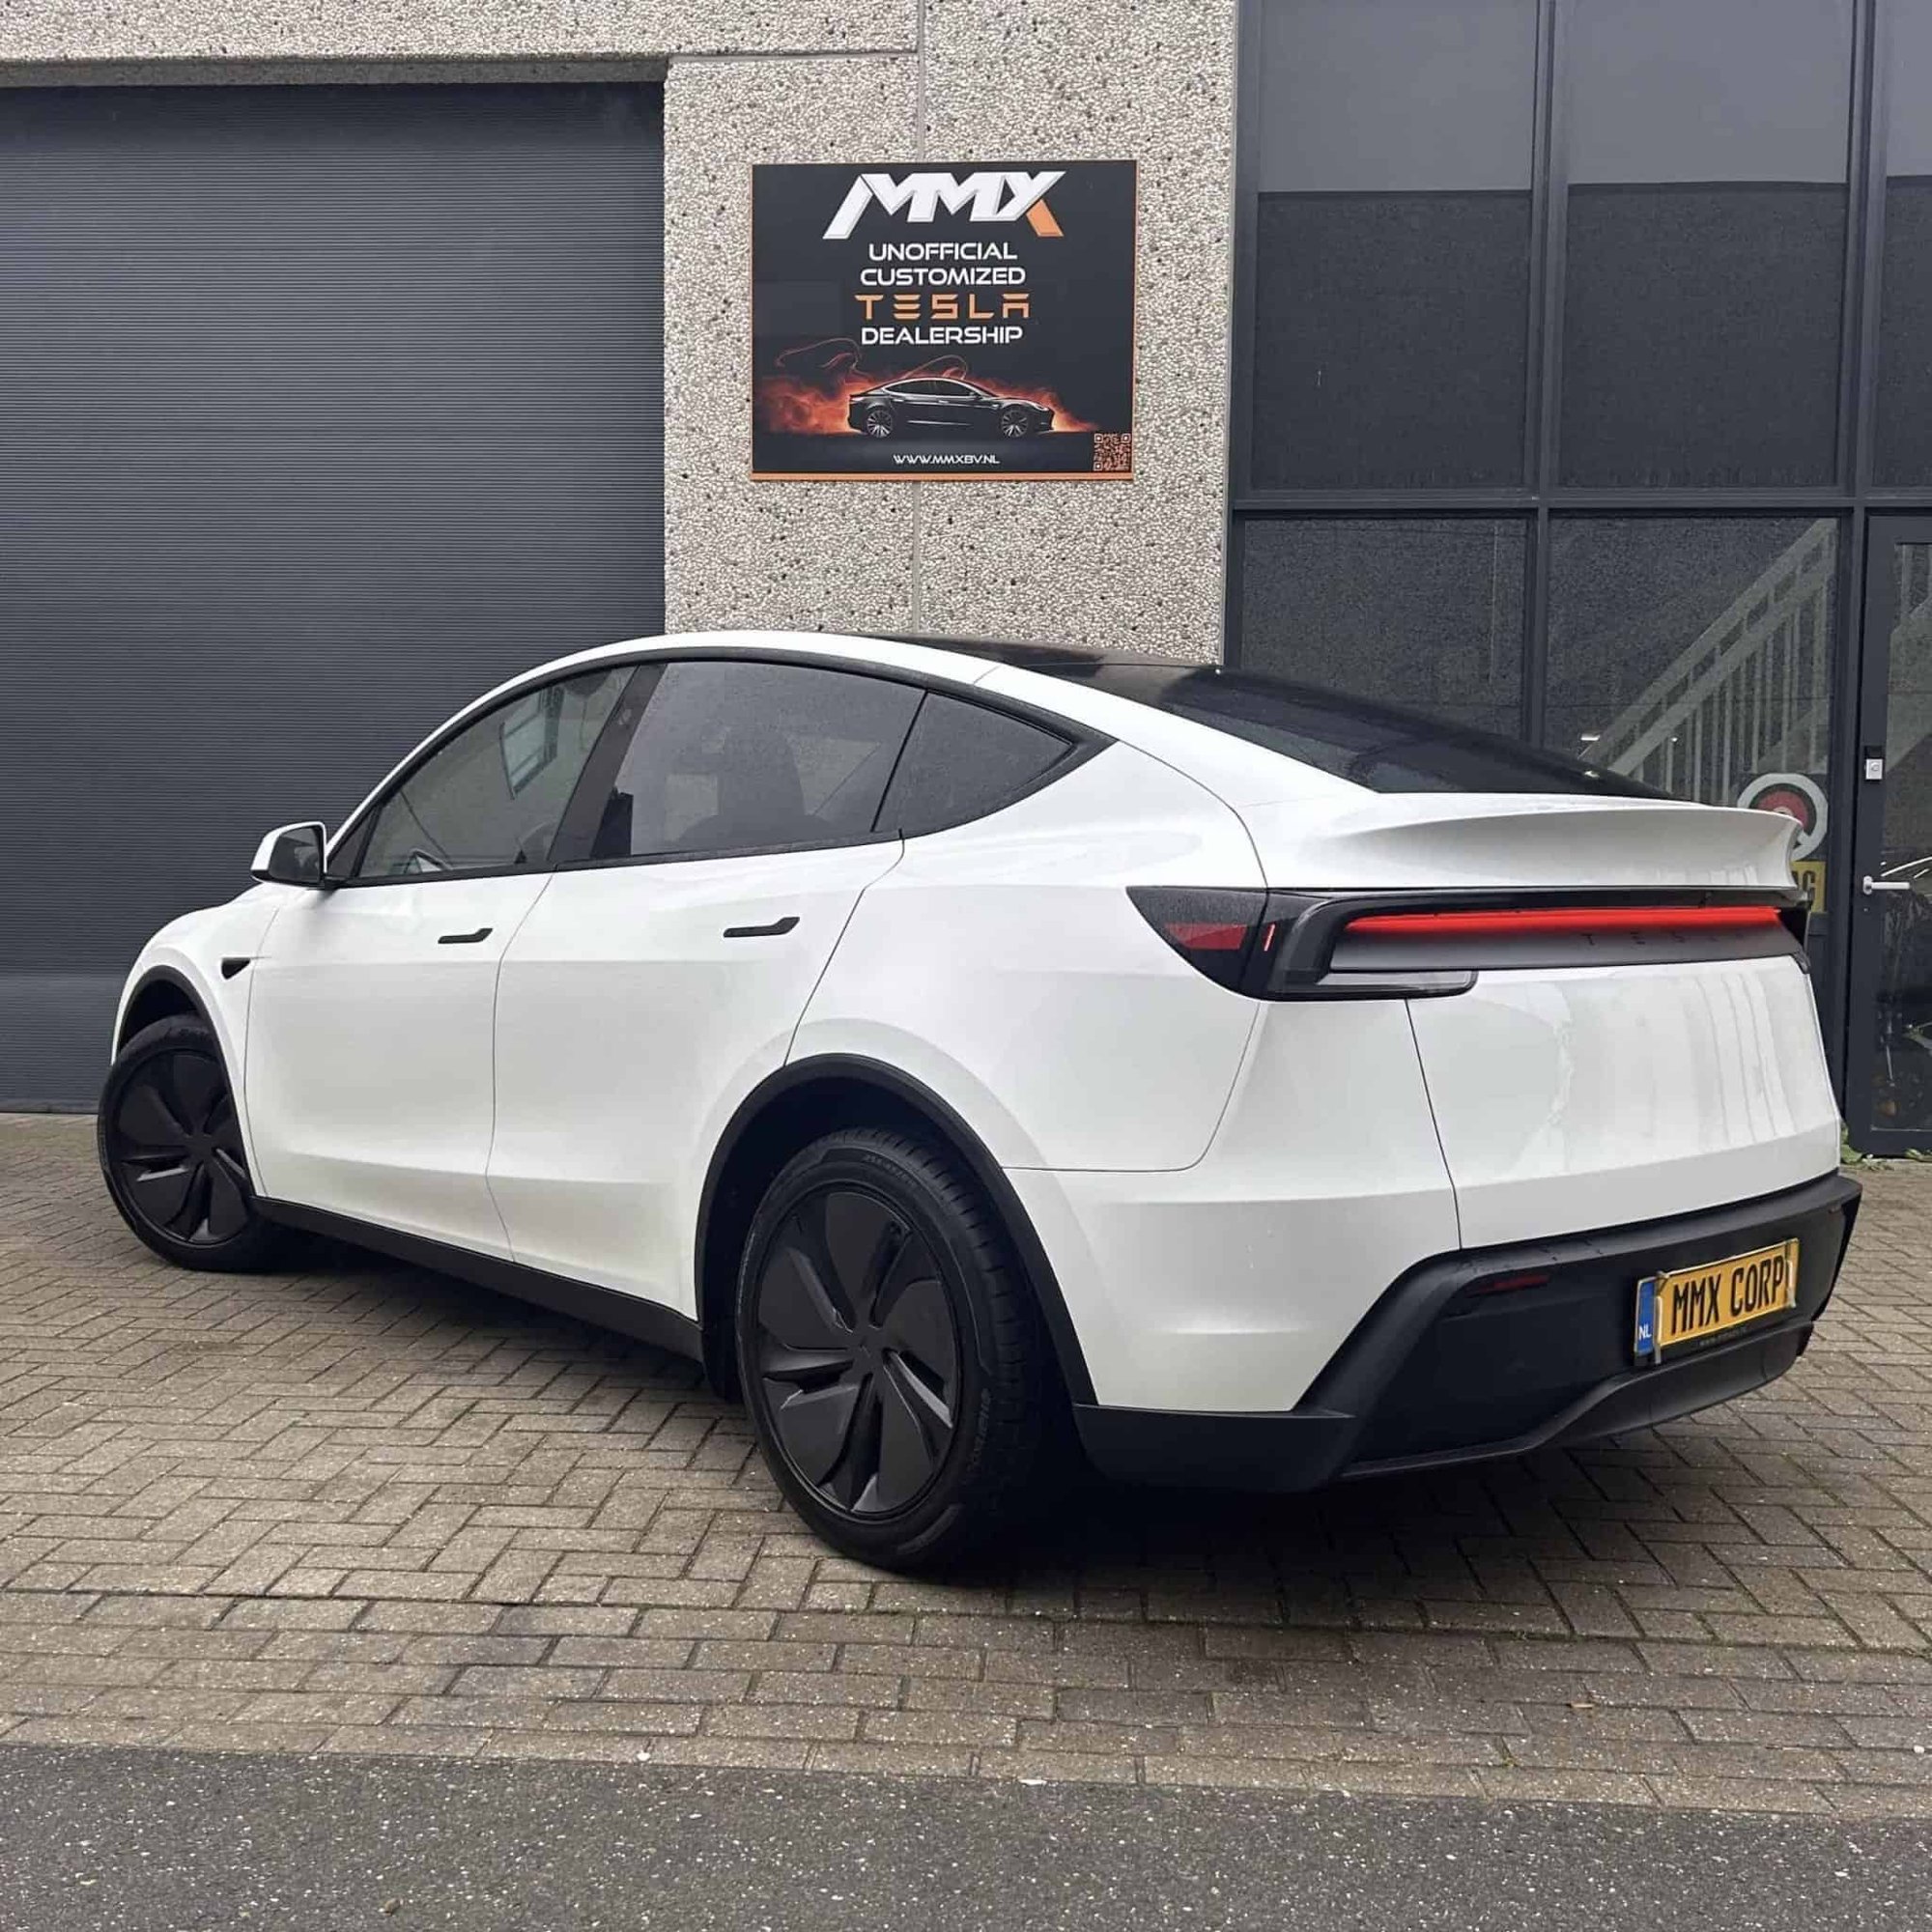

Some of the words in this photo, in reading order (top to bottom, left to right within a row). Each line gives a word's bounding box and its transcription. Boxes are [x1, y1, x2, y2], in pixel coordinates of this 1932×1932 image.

[822, 170, 1066, 240] MMX
[868, 242, 1018, 261] UNOFFICIAL
[860, 267, 1026, 287] CUSTOMIZED
[855, 293, 1030, 320] TESLA
[861, 326, 1023, 346] DEALERSHIP
[893, 454, 1001, 465] WWW.MMXBV.NL
[1670, 1273, 1721, 1336] MMX
[1730, 1255, 1784, 1318] CORP
[1638, 1323, 1653, 1341] NL
